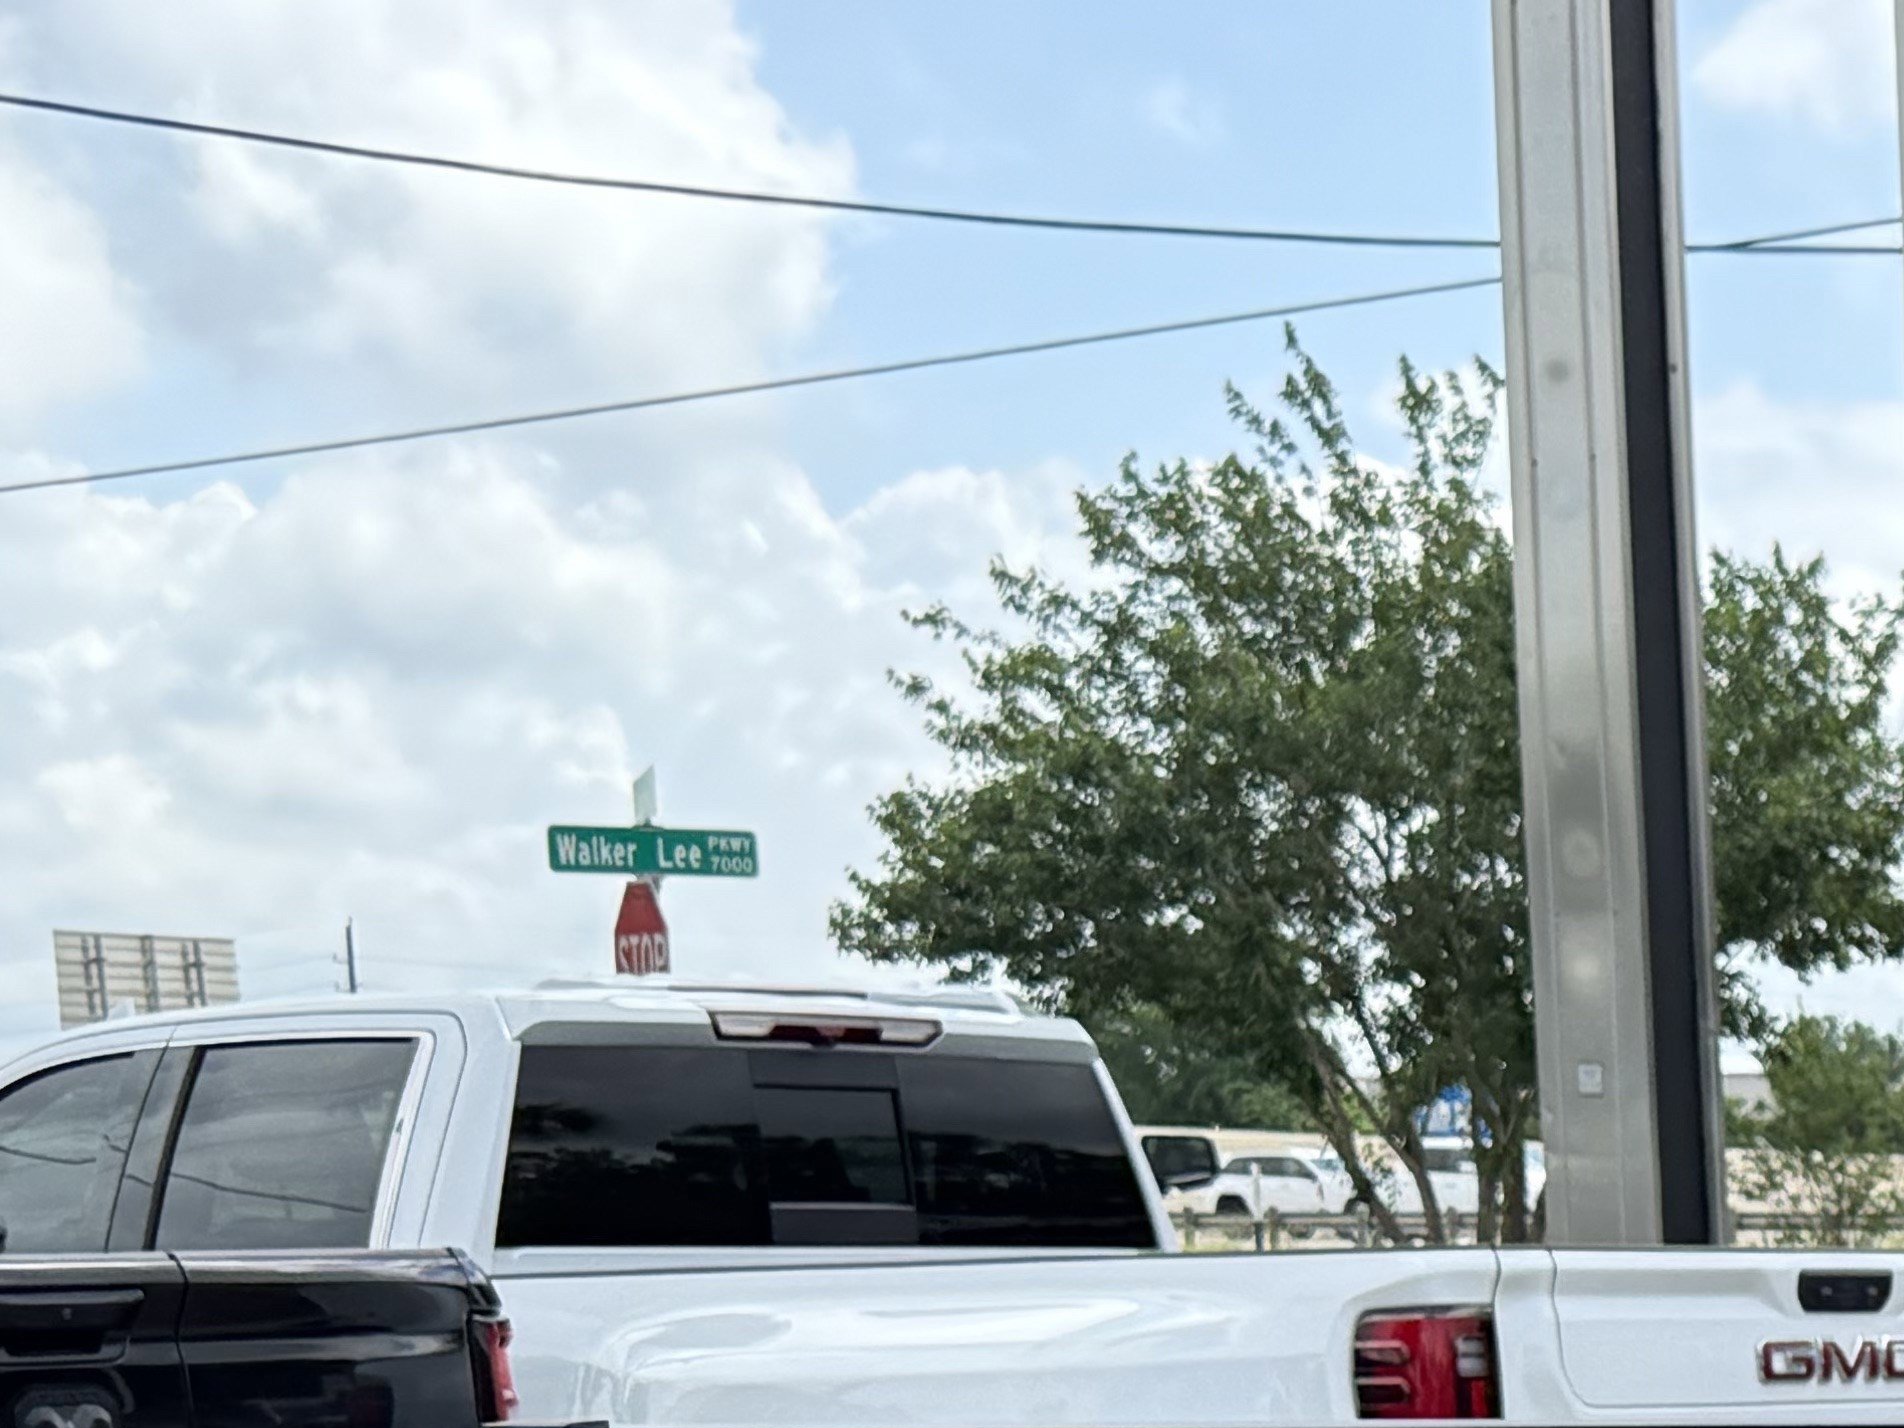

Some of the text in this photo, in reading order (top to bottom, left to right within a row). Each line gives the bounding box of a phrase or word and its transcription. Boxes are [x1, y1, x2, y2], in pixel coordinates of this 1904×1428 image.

[556, 833, 750, 869] Walker Lee PKWY
[710, 856, 753, 874] 7000
